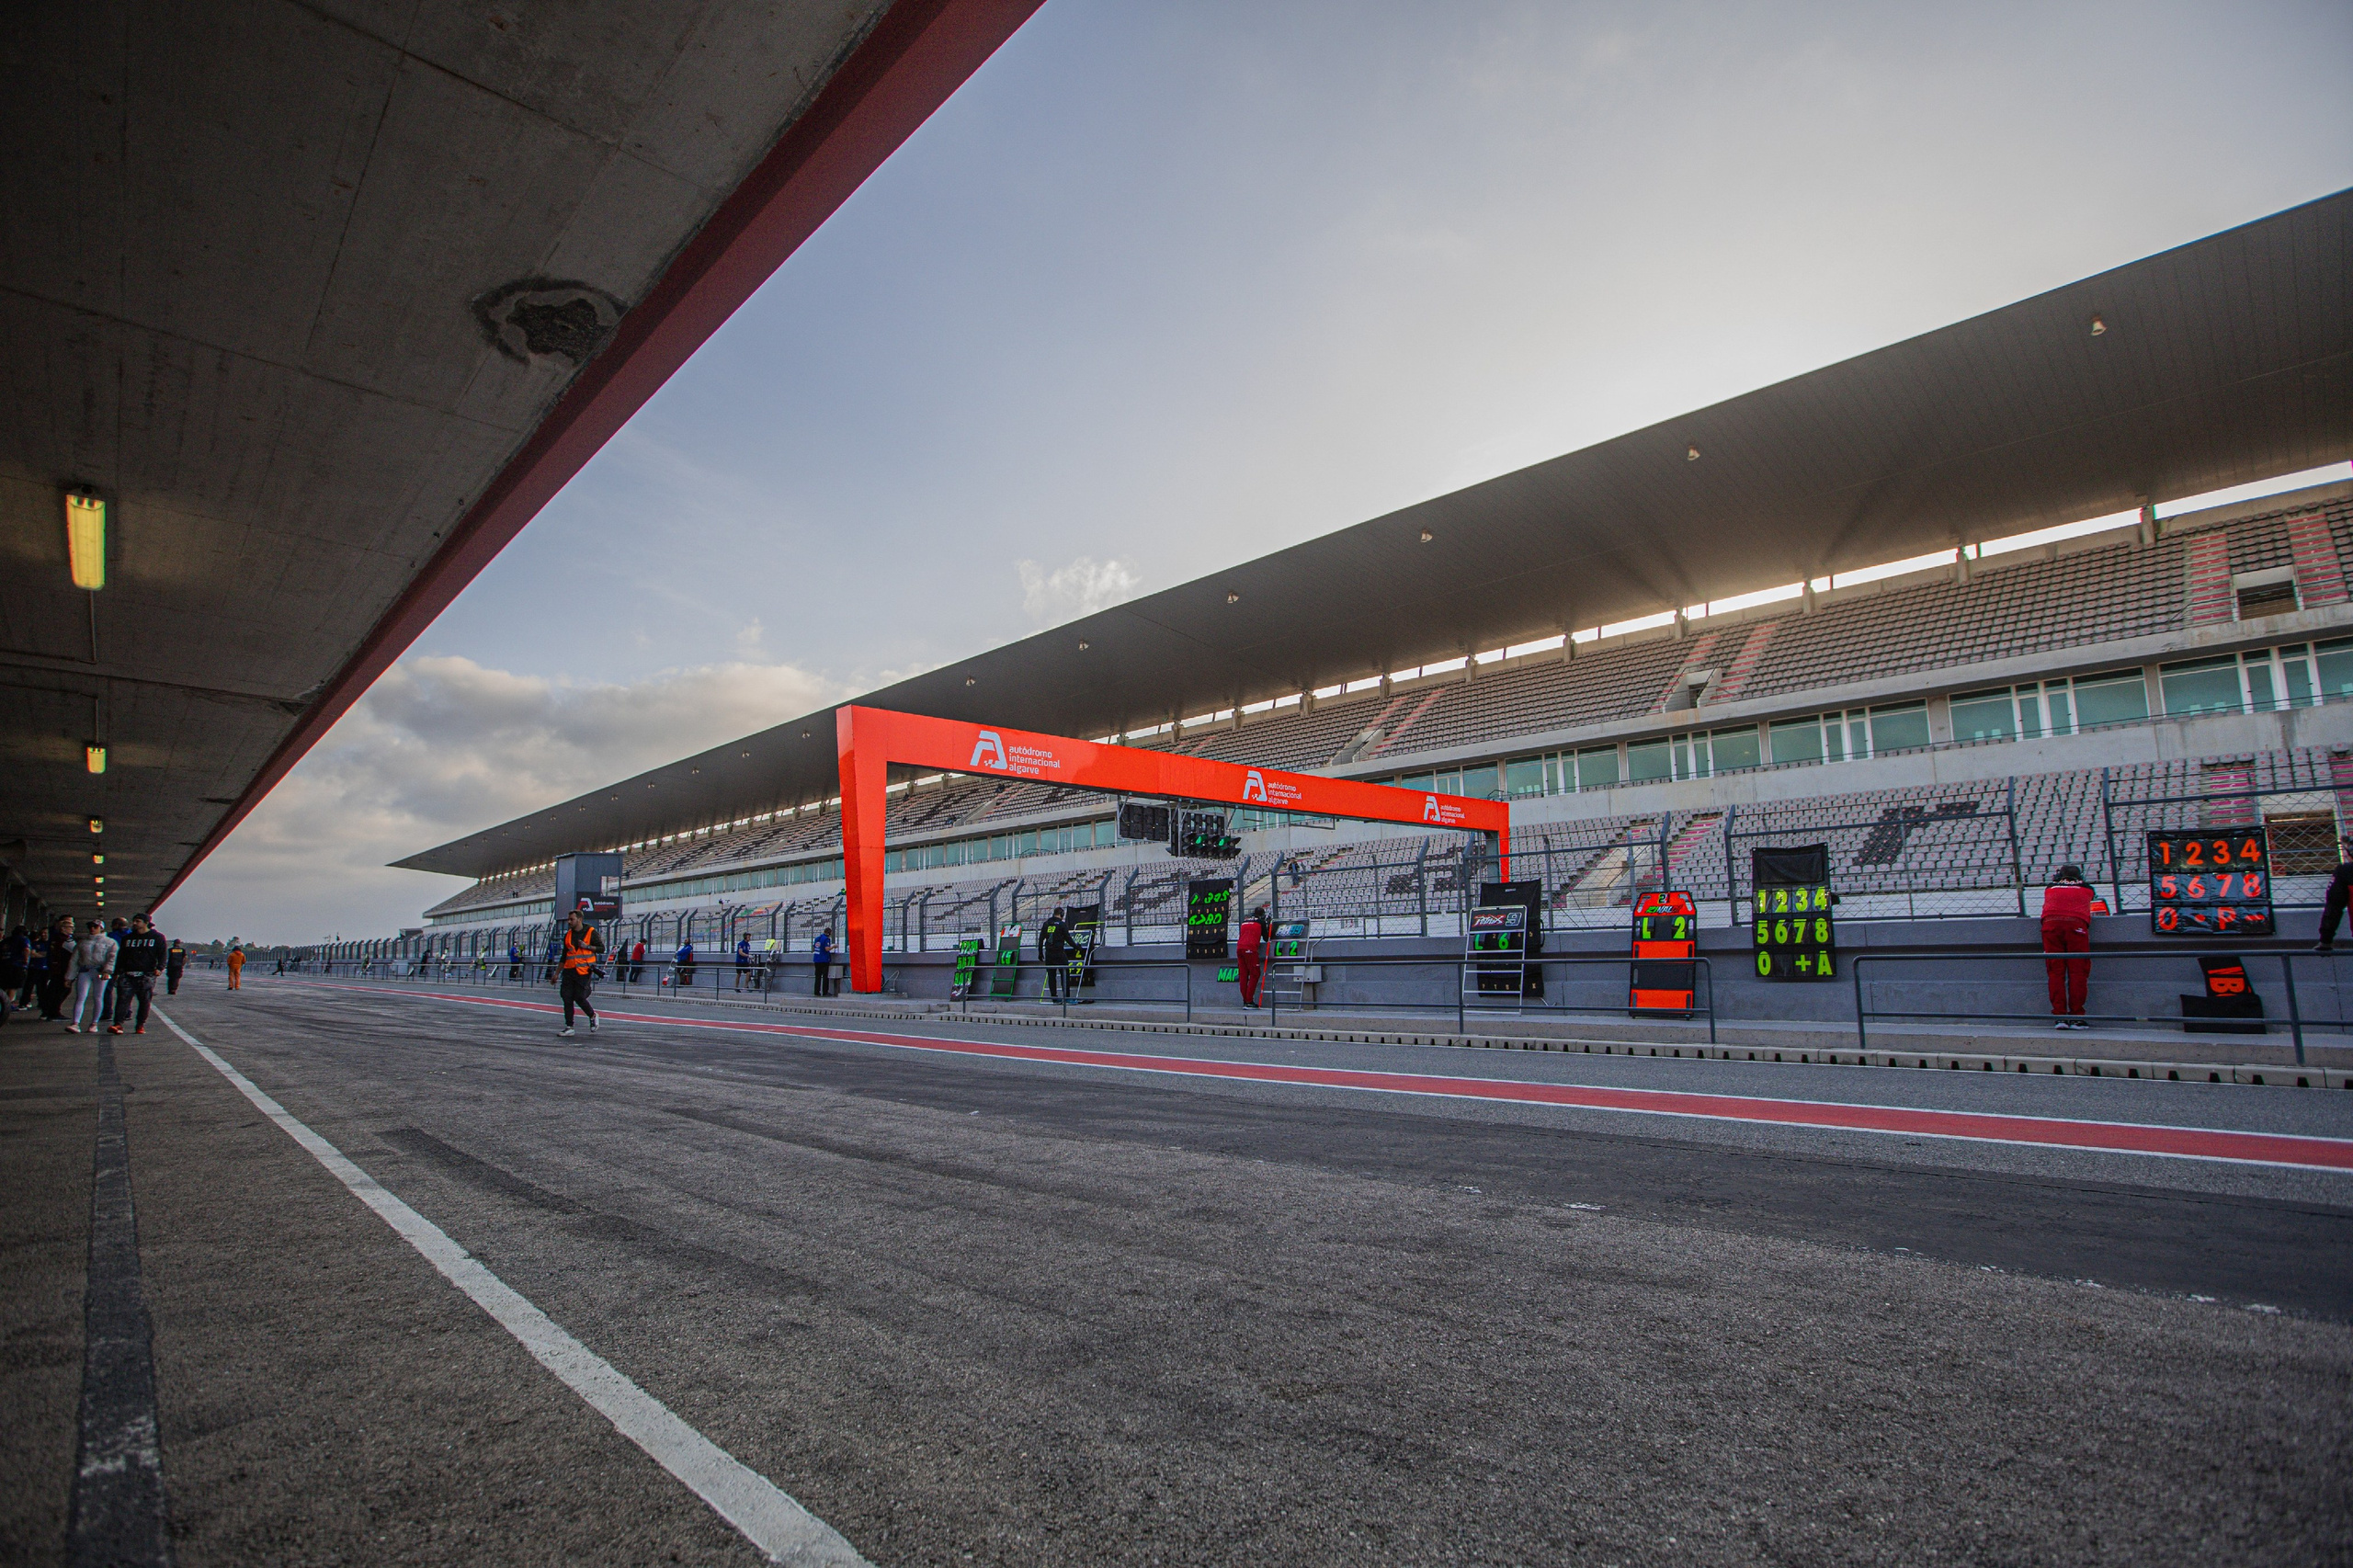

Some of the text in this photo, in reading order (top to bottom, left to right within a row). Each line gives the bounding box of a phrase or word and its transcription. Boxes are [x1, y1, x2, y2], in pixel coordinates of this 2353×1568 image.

[1008, 745, 1052, 758] autódromo
[1008, 753, 1061, 768] internacional
[1008, 764, 1040, 775] algarve
[1673, 916, 1686, 938] 2
[1290, 940, 1298, 956] 2
[1498, 932, 1509, 949] 6
